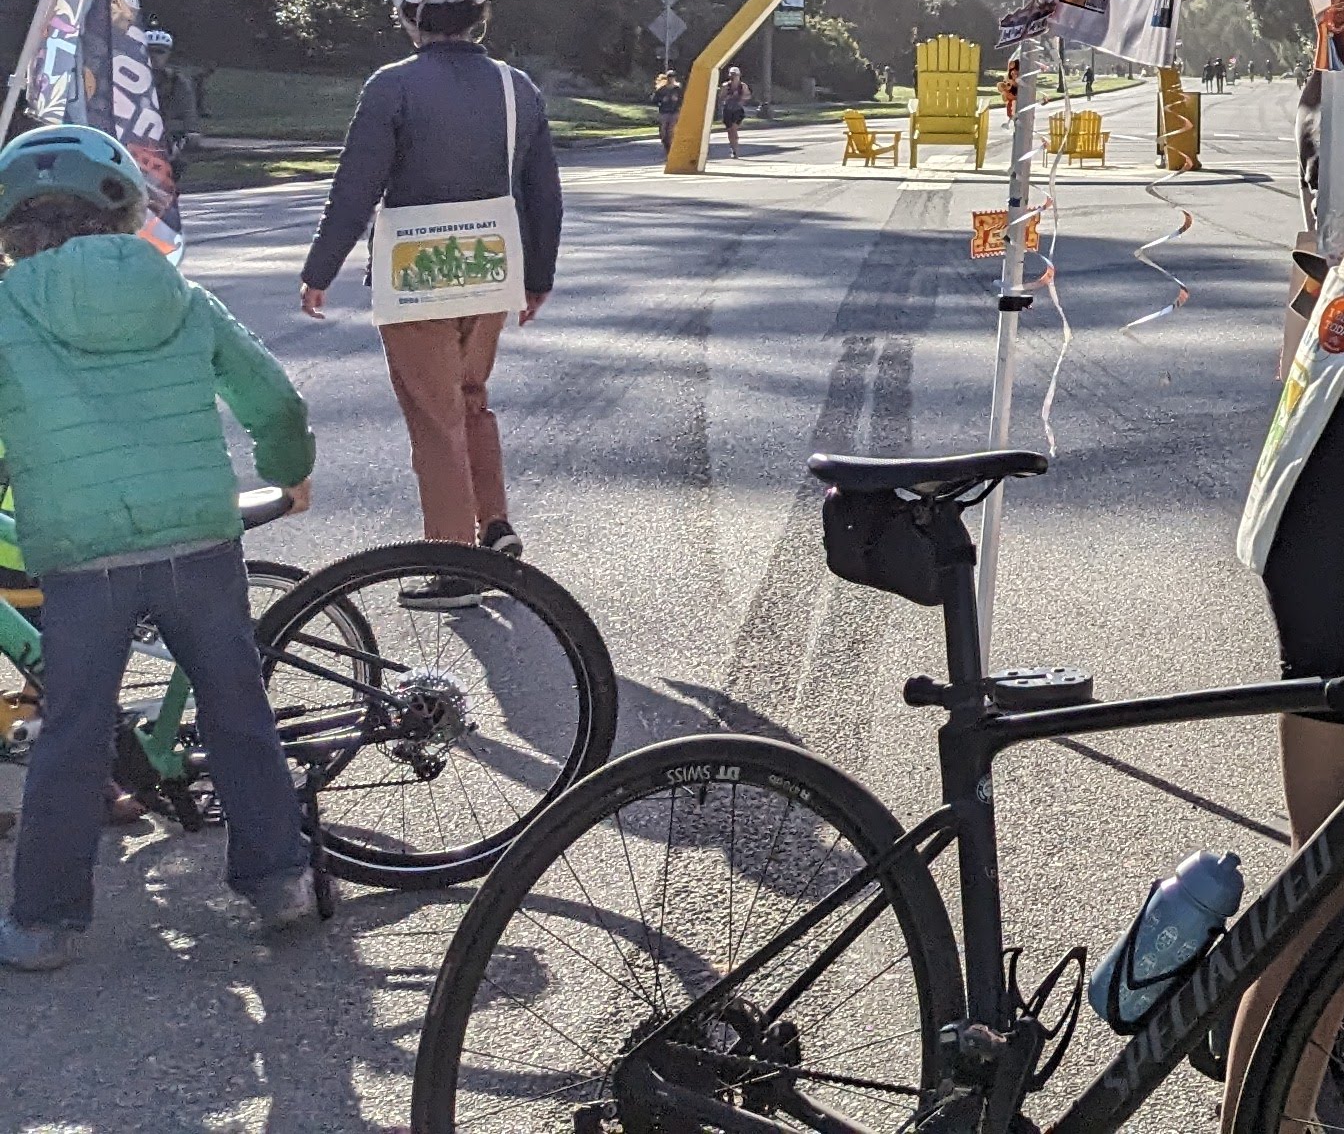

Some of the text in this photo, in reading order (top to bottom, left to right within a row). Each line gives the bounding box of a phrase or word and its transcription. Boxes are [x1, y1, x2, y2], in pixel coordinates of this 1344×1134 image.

[666, 765, 741, 785] DT SWISS
[1103, 832, 1332, 1115] SPECIALIZED
